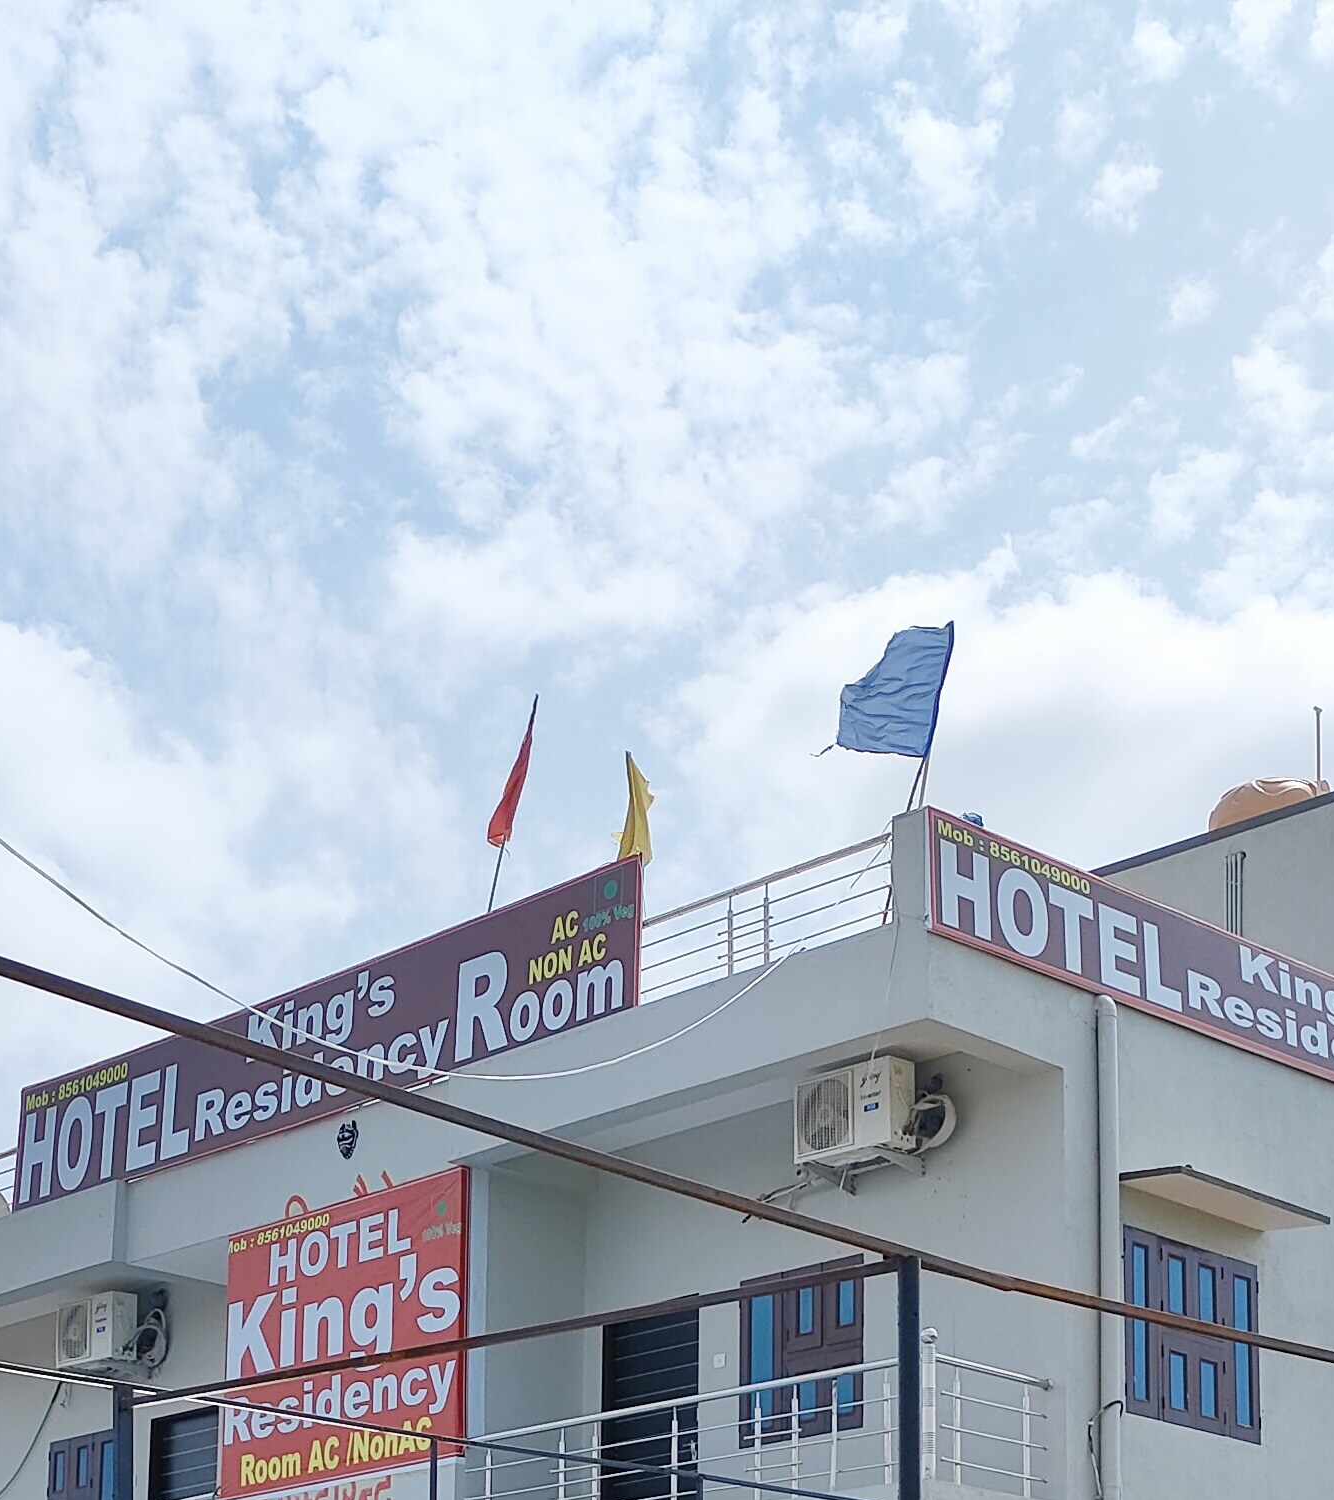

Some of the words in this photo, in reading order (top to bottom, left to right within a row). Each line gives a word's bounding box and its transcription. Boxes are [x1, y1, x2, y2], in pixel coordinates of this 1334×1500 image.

[937, 818, 974, 847] Mob
[989, 841, 1091, 895] 8561049000
[528, 946, 572, 985] NON
[578, 933, 607, 967] AC
[551, 910, 579, 945] AC
[940, 838, 1183, 1013] HOTEL
[246, 970, 395, 1064] King's
[454, 951, 624, 1063] Room
[26, 1091, 49, 1111] Mob
[58, 1062, 129, 1100] 8561049000
[194, 1019, 449, 1142] Residency
[18, 1063, 190, 1204] HOTEL
[257, 1213, 330, 1246] 8561049000
[269, 1208, 411, 1287] HOTEL
[227, 1253, 461, 1372] King's
[224, 1359, 457, 1446] Residency
[240, 1452, 301, 1487] Room
[308, 1436, 340, 1474] AC
